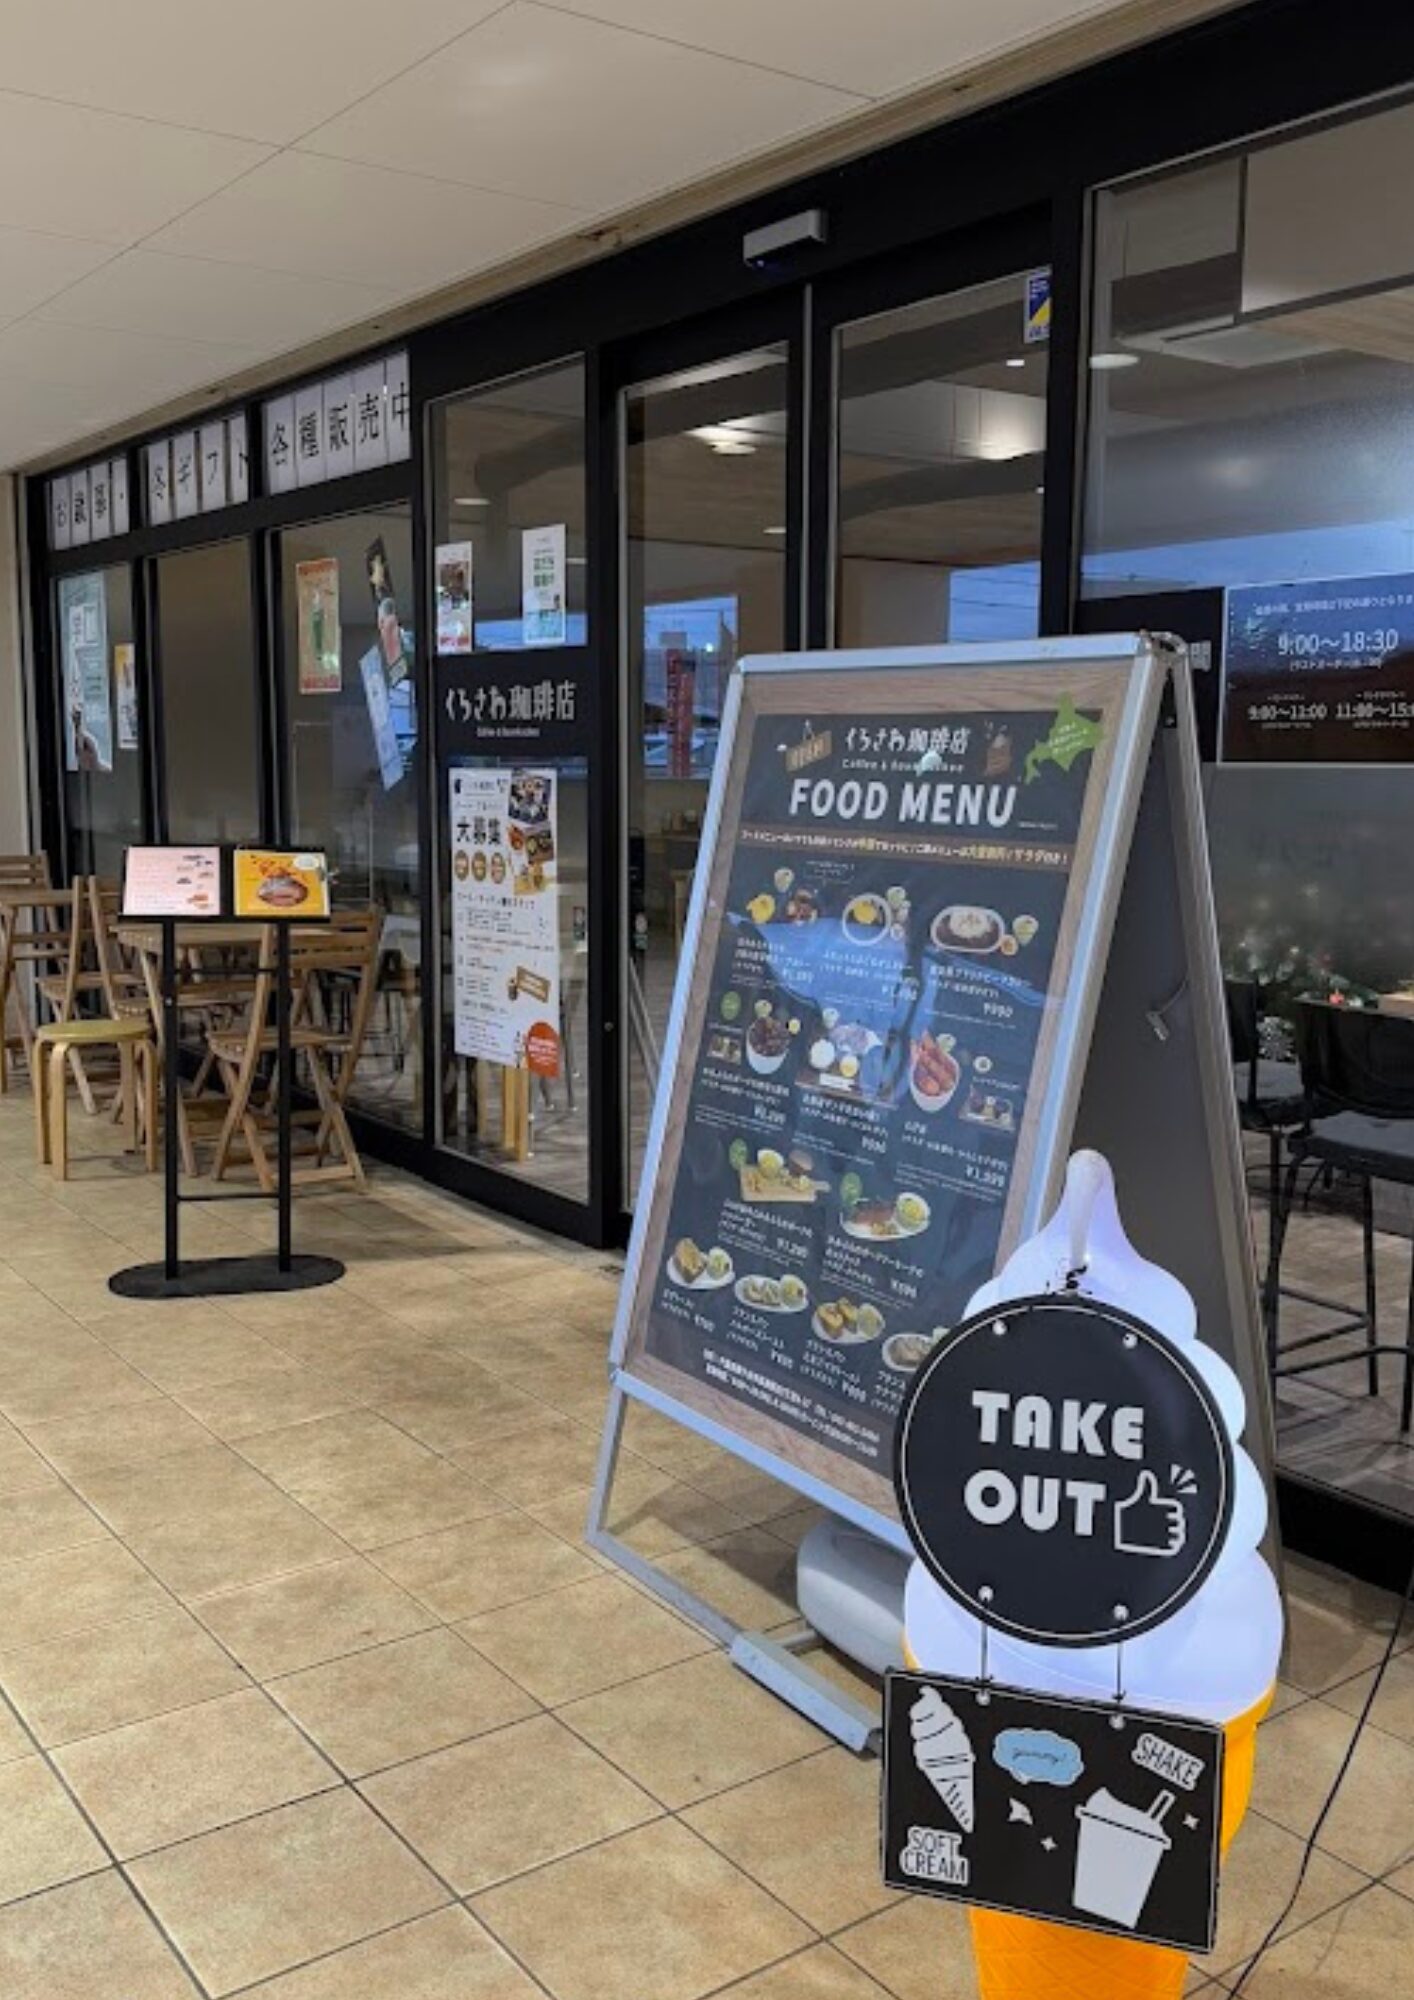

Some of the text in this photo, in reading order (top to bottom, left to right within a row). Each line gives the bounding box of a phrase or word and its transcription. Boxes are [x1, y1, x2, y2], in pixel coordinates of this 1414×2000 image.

[270, 382, 410, 467] 各種販売中
[445, 679, 577, 722] くろさわ珈琲店
[845, 725, 971, 755] くろさわ珈琲店
[788, 778, 1018, 829] FOOD MENU
[971, 1389, 1146, 1463] TAKE
[963, 1468, 1108, 1538] OUT
[1136, 1733, 1201, 1786] SHAKE
[904, 1849, 966, 1882] CREAM
[908, 1828, 960, 1856] SOFT
